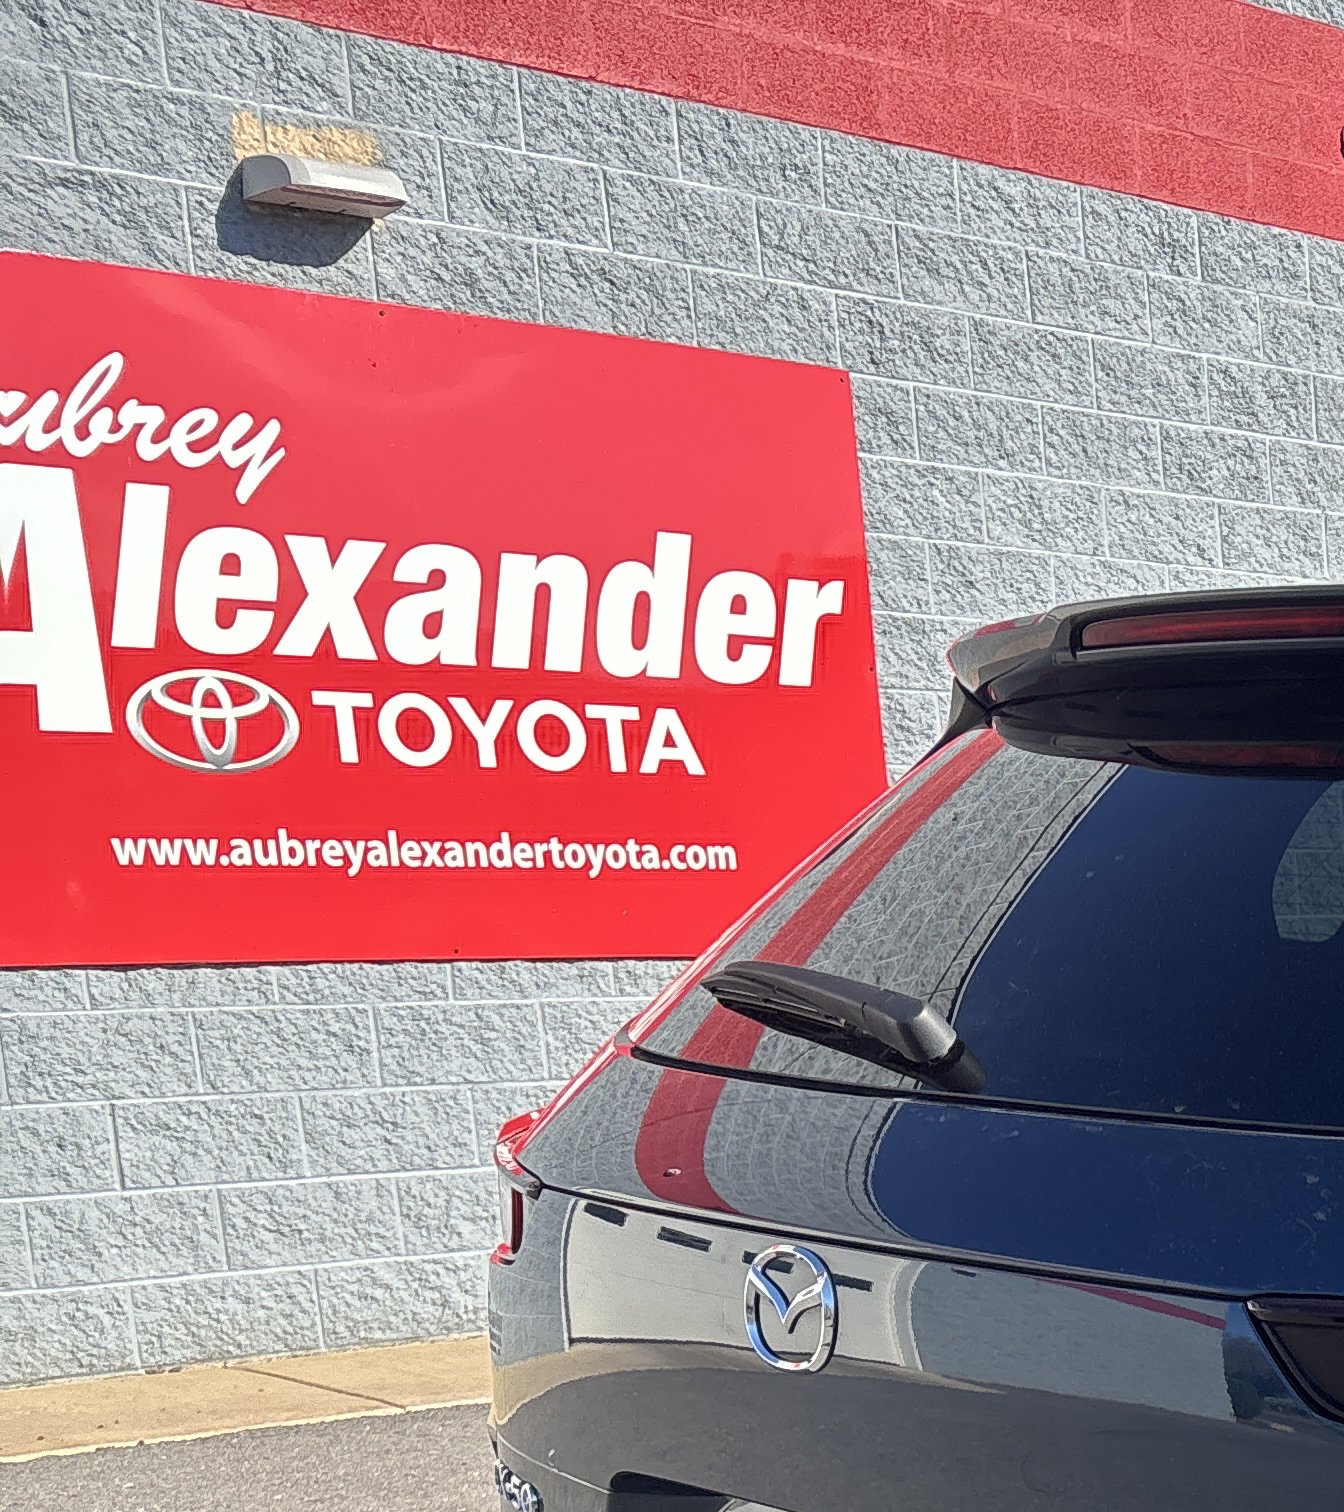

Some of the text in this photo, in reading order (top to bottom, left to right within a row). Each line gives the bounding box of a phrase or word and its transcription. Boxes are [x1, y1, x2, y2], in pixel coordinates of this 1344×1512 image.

[0, 351, 286, 505] ubrey
[0, 462, 845, 733] Alexander
[311, 691, 706, 776] TOYOTA
[110, 828, 738, 879] www.aubreyalexandertoyota.com
